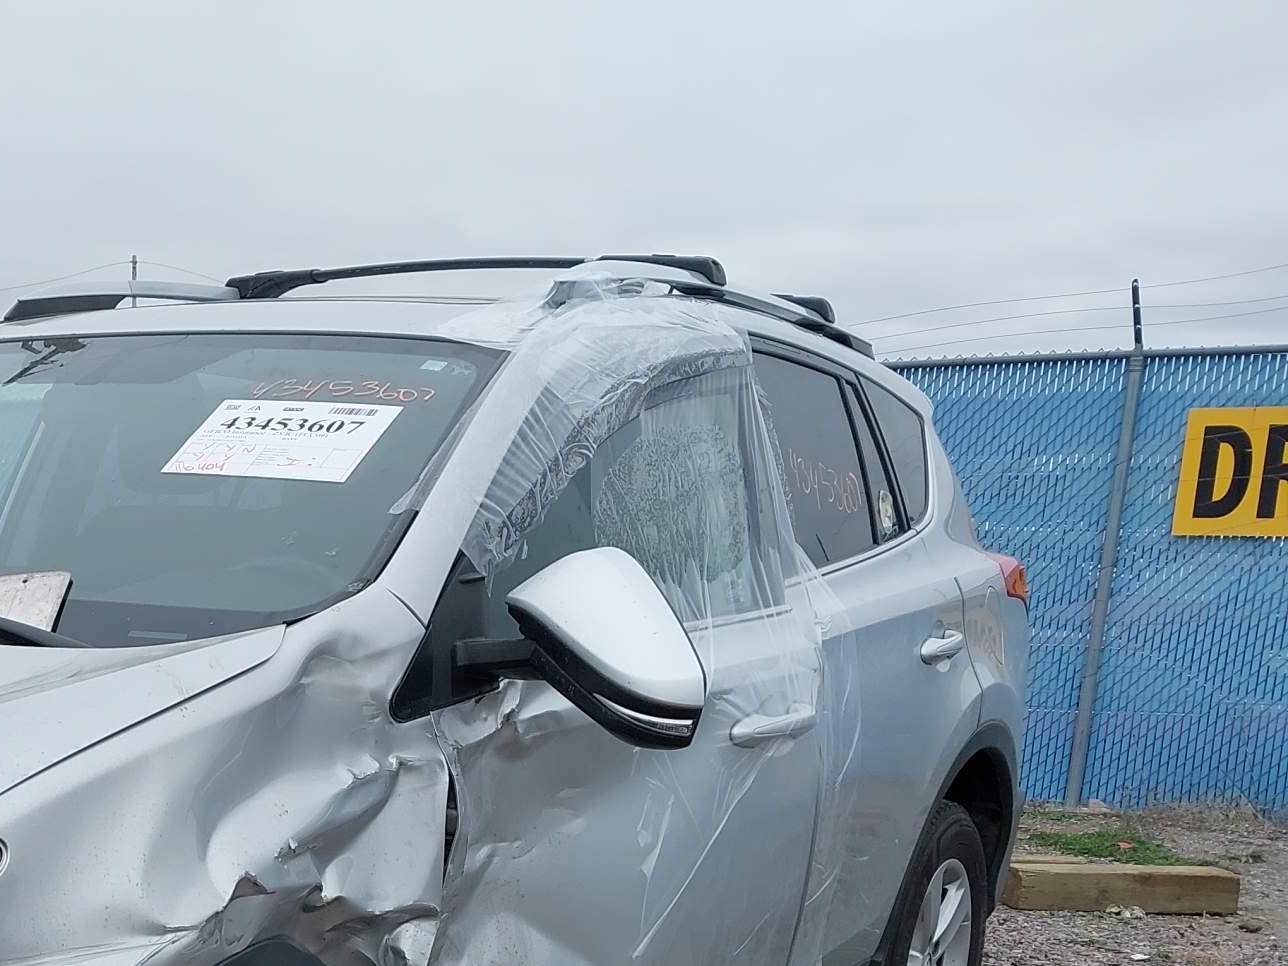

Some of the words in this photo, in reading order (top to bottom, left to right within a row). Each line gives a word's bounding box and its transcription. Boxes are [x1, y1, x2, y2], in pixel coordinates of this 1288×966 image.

[253, 379, 436, 401] 43453607
[220, 416, 367, 434] 43453607
[1192, 424, 1288, 519] DR
